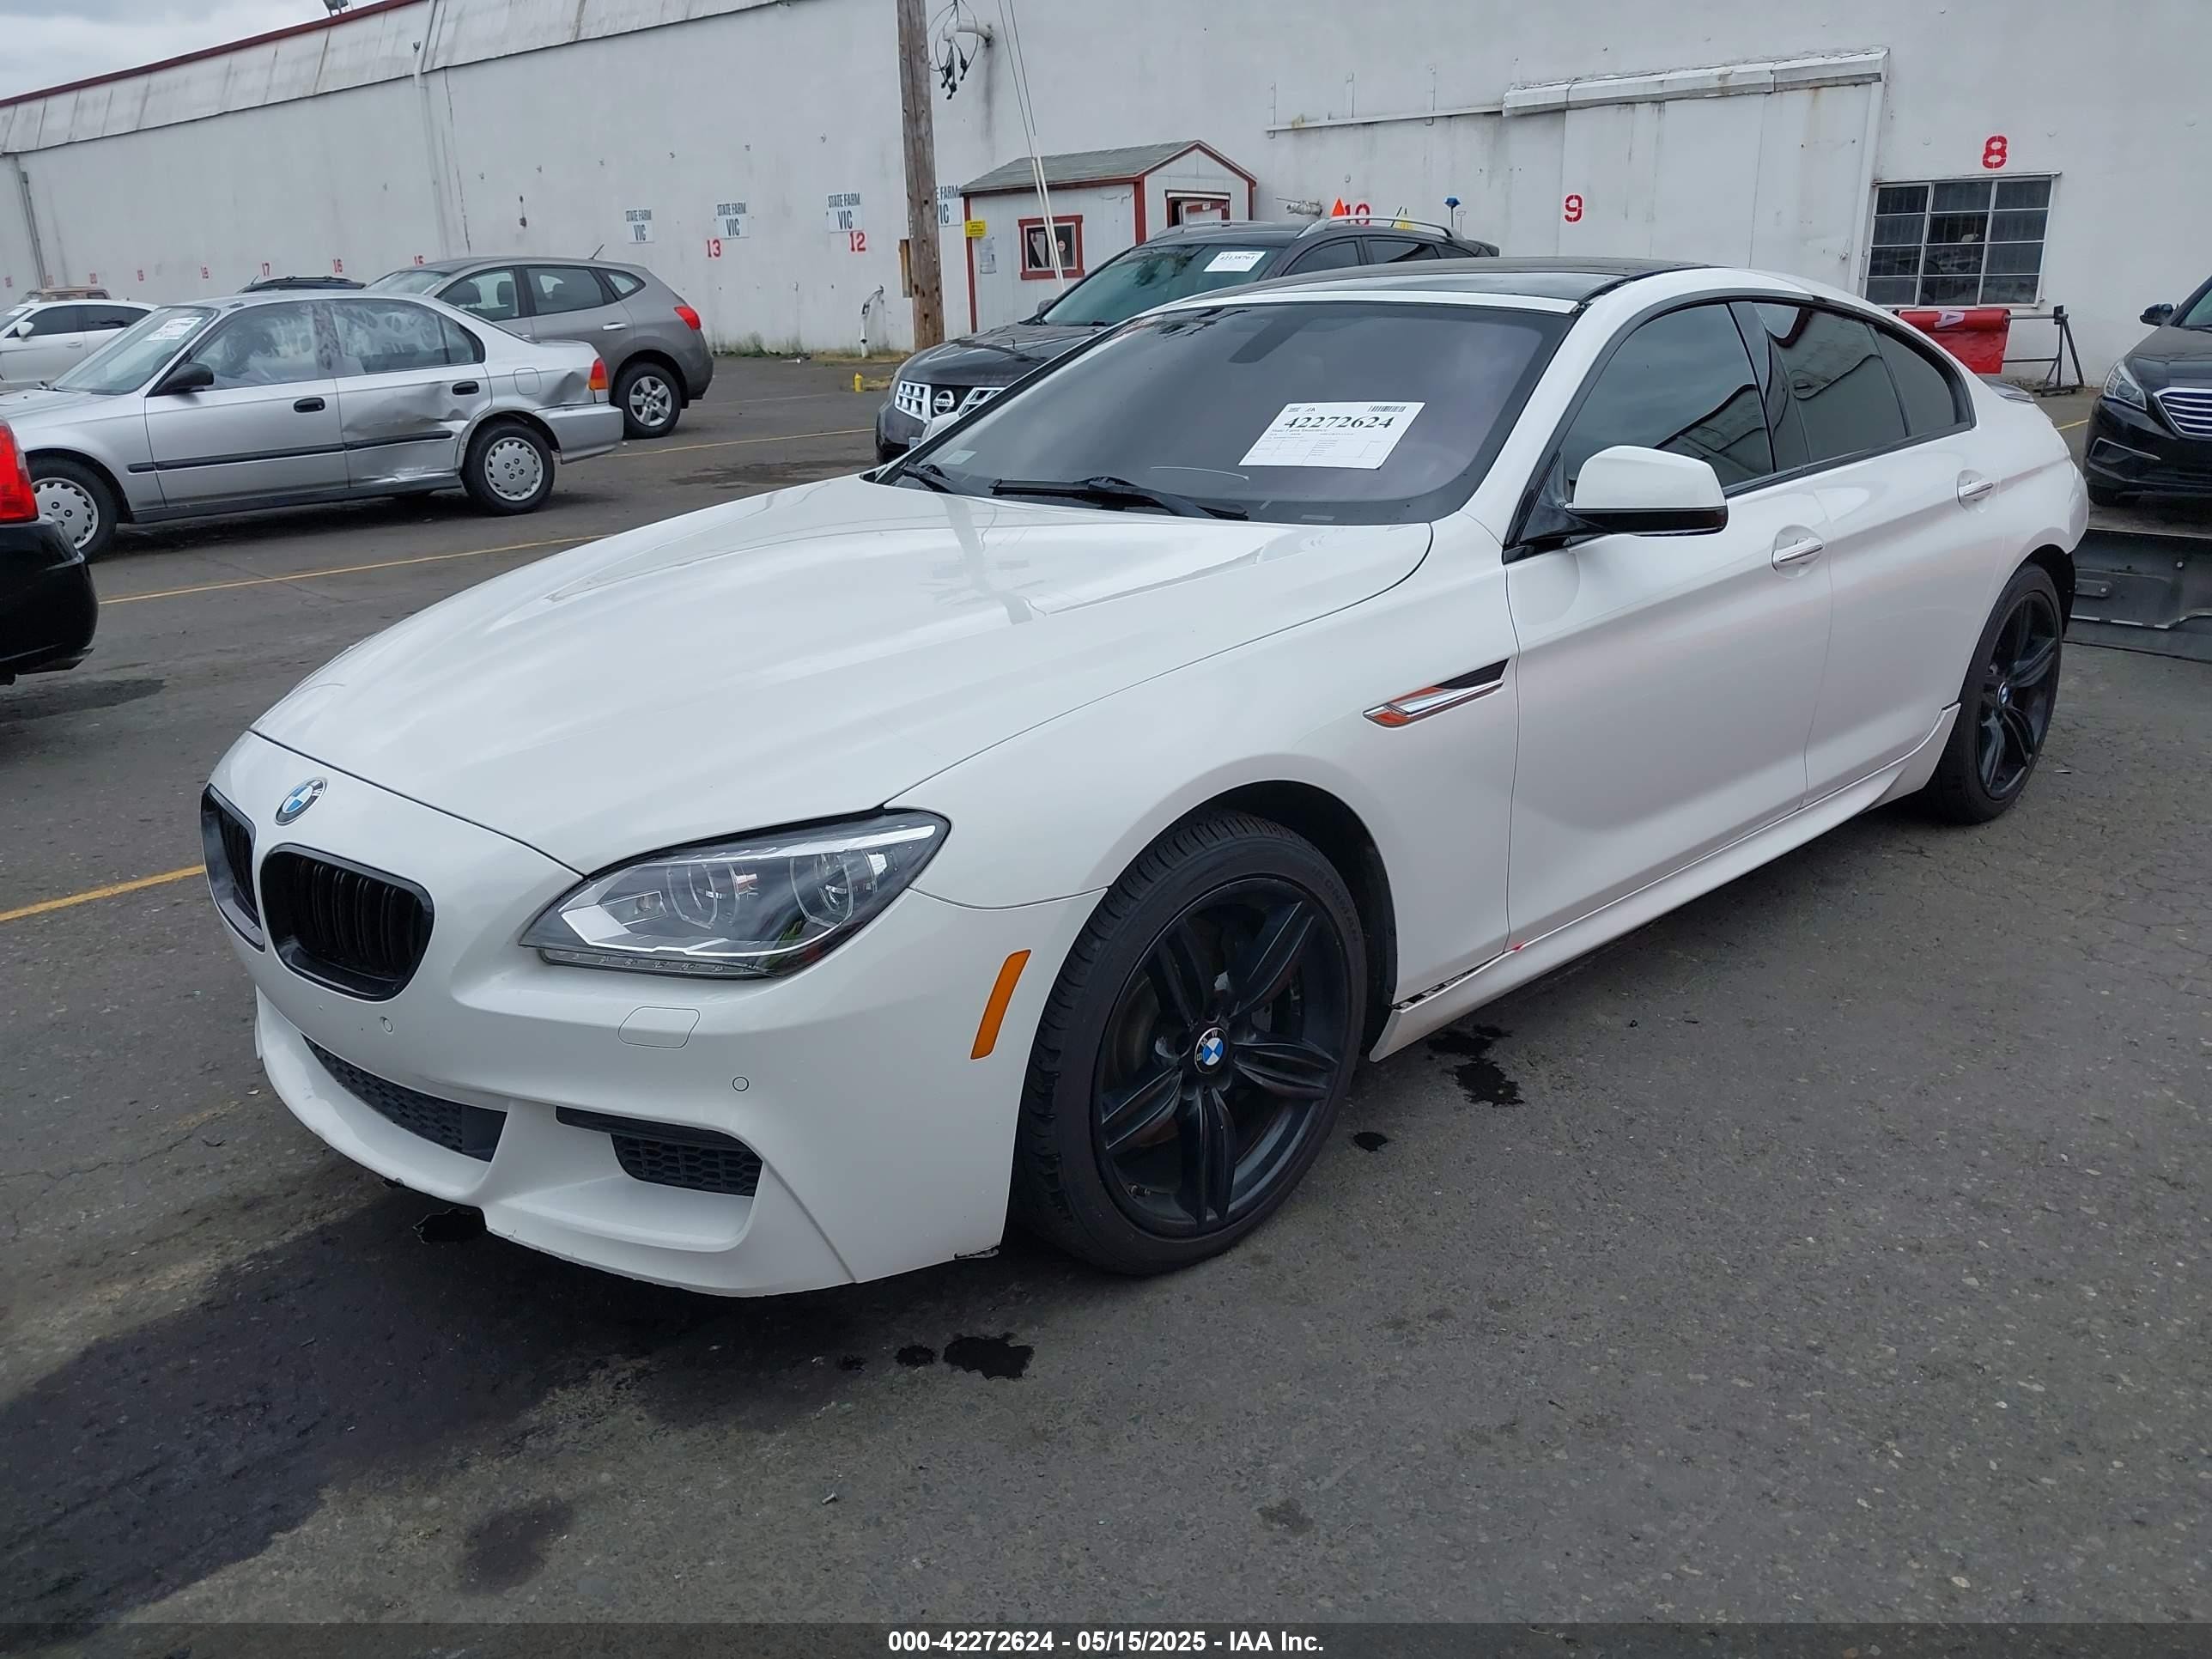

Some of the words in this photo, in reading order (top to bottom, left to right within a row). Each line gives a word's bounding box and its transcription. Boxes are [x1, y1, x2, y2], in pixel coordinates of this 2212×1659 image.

[1982, 135, 2008, 169] 8
[717, 204, 732, 216] STATE
[732, 202, 746, 215] FARM
[828, 194, 843, 208] STATE
[844, 193, 860, 206] FARM
[1564, 194, 1583, 223] 9
[837, 210, 853, 230] VIC
[1345, 203, 1370, 226] 10
[634, 224, 647, 240] VIC
[726, 217, 740, 236] VIC
[707, 239, 721, 258] 13
[849, 232, 866, 252] 12
[261, 262, 271, 276] 17
[332, 258, 343, 274] 16
[1285, 416, 1395, 428] 42272624
[1196, 1030, 1219, 1061] BMW
